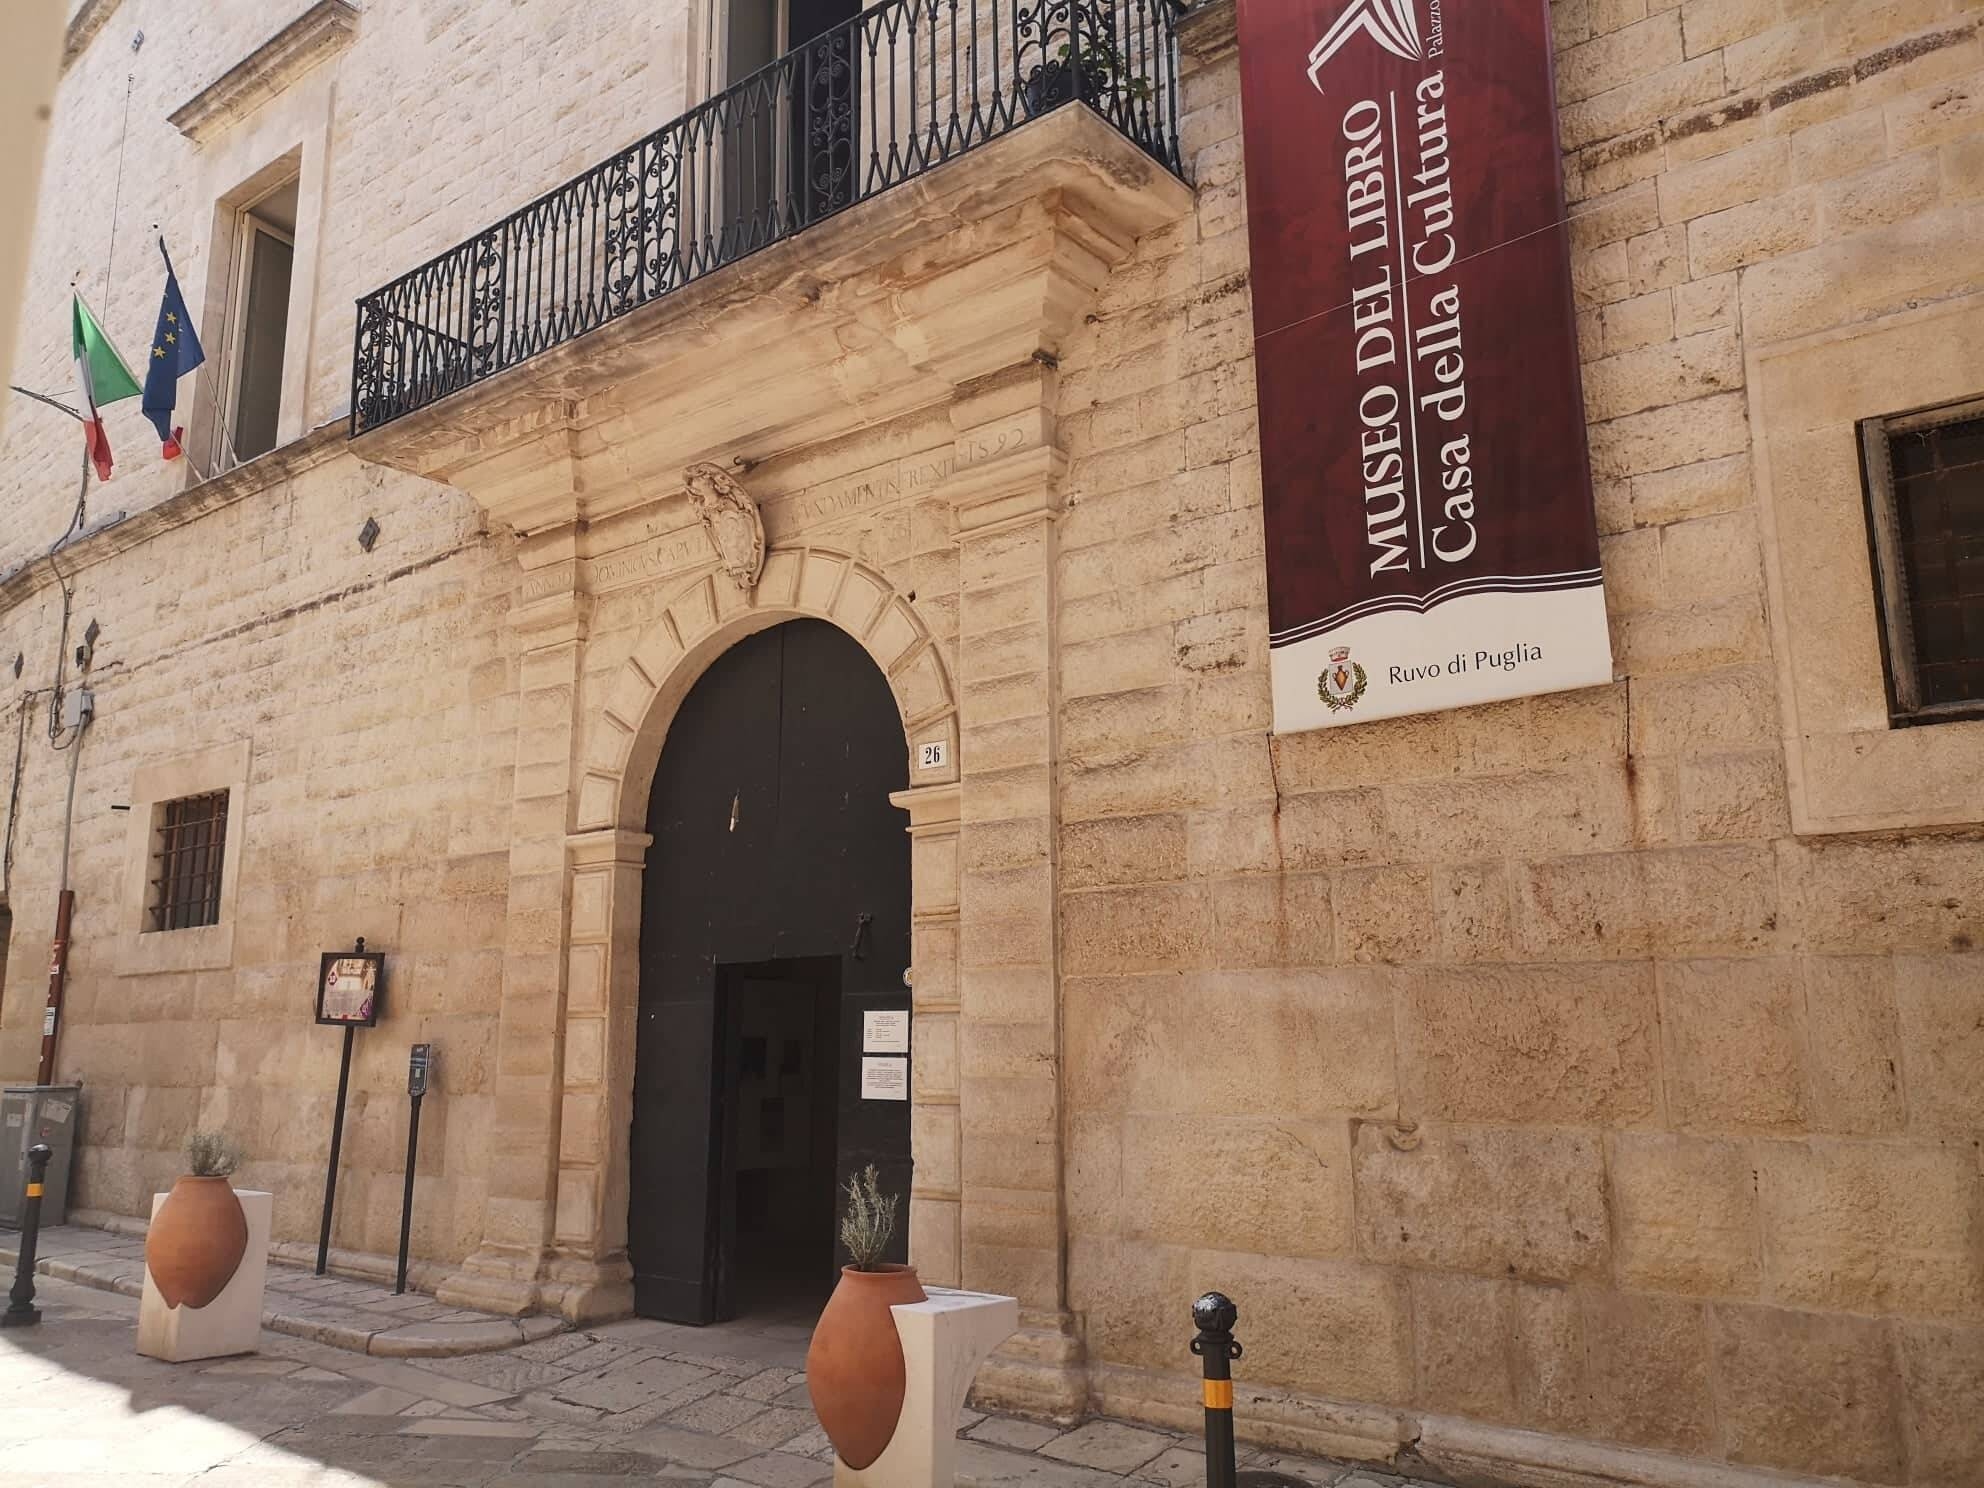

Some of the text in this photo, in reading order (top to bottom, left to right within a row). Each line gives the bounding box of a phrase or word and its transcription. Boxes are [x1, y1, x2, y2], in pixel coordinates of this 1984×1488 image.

[1426, 0, 1444, 58] Palazzo
[1342, 100, 1411, 579] MUSEO DEL LIBRO
[1407, 70, 1477, 563] Casa della Cultura
[1389, 642, 1543, 685] Ruvo di Puglia
[925, 745, 941, 765] 26
